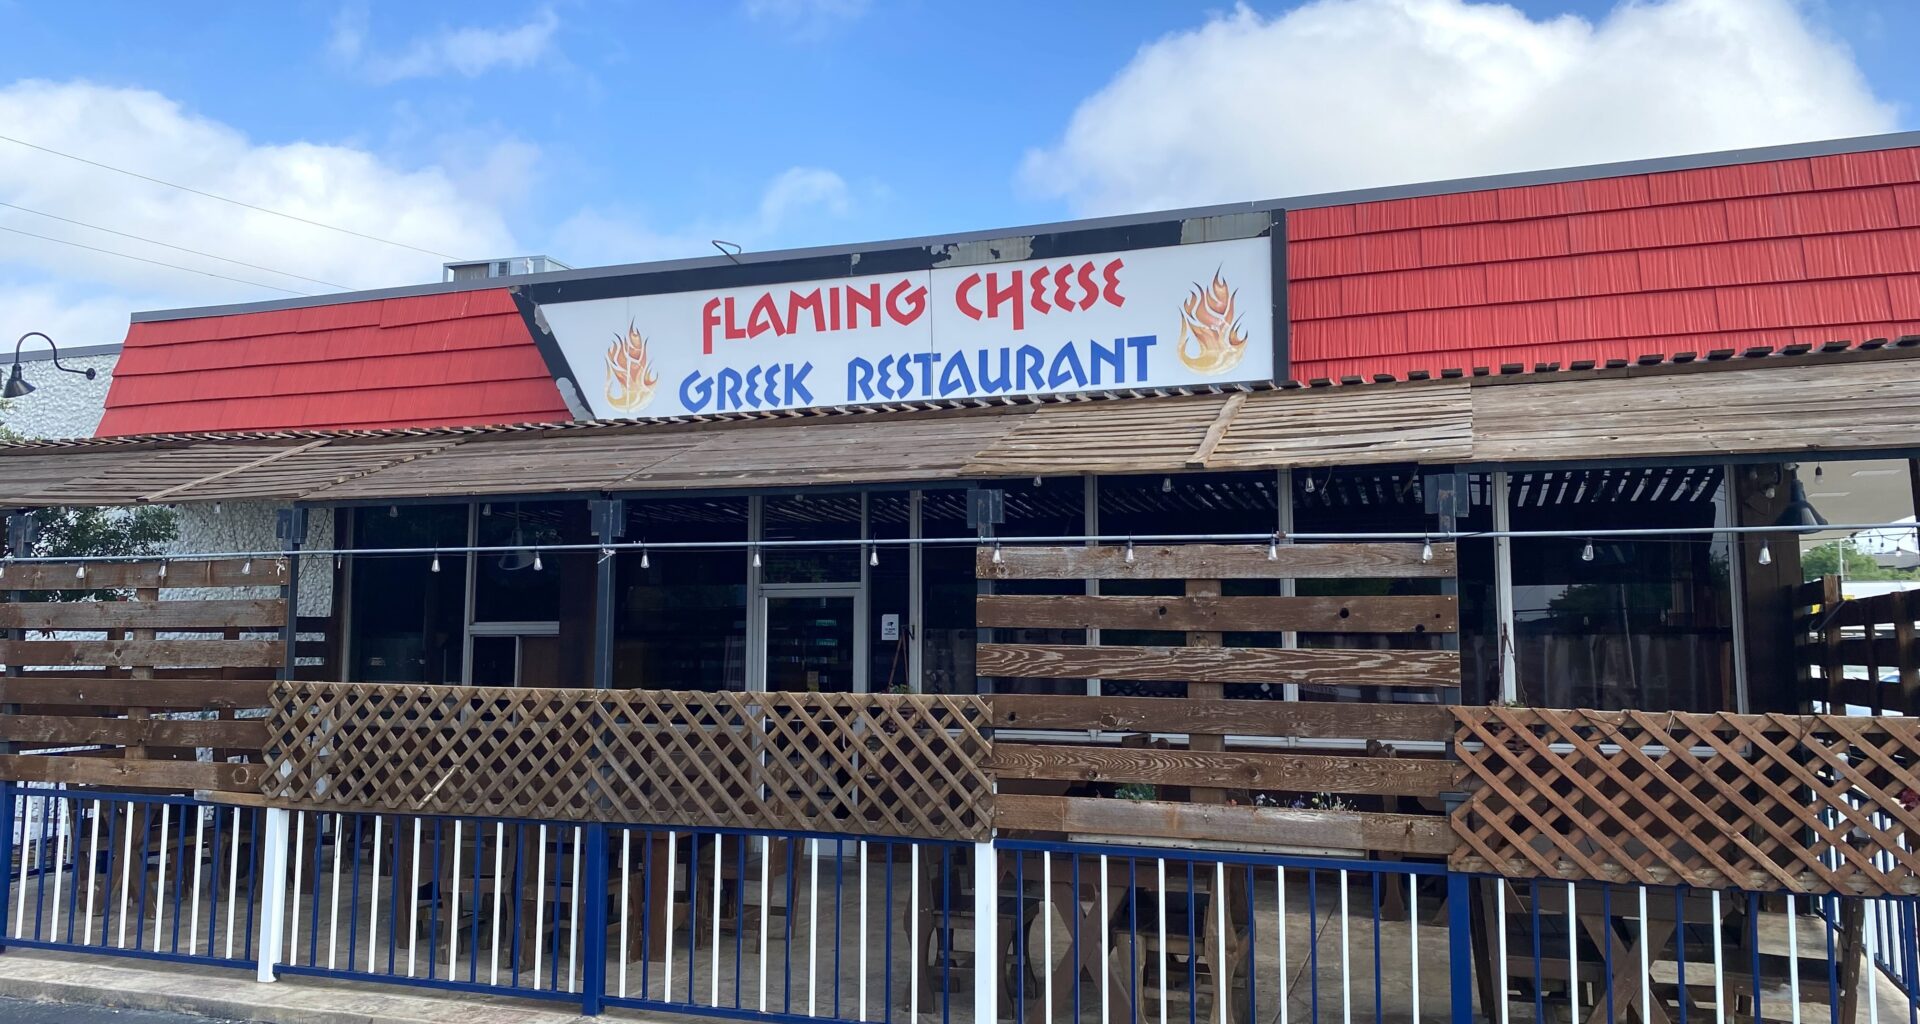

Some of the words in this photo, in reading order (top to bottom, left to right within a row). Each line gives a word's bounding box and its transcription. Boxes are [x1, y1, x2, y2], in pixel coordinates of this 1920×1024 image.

[703, 279, 928, 354] FLAMING
[956, 258, 1125, 330] CHEESE
[678, 361, 814, 414] GREEK
[846, 334, 1158, 402] RESTAURANT
